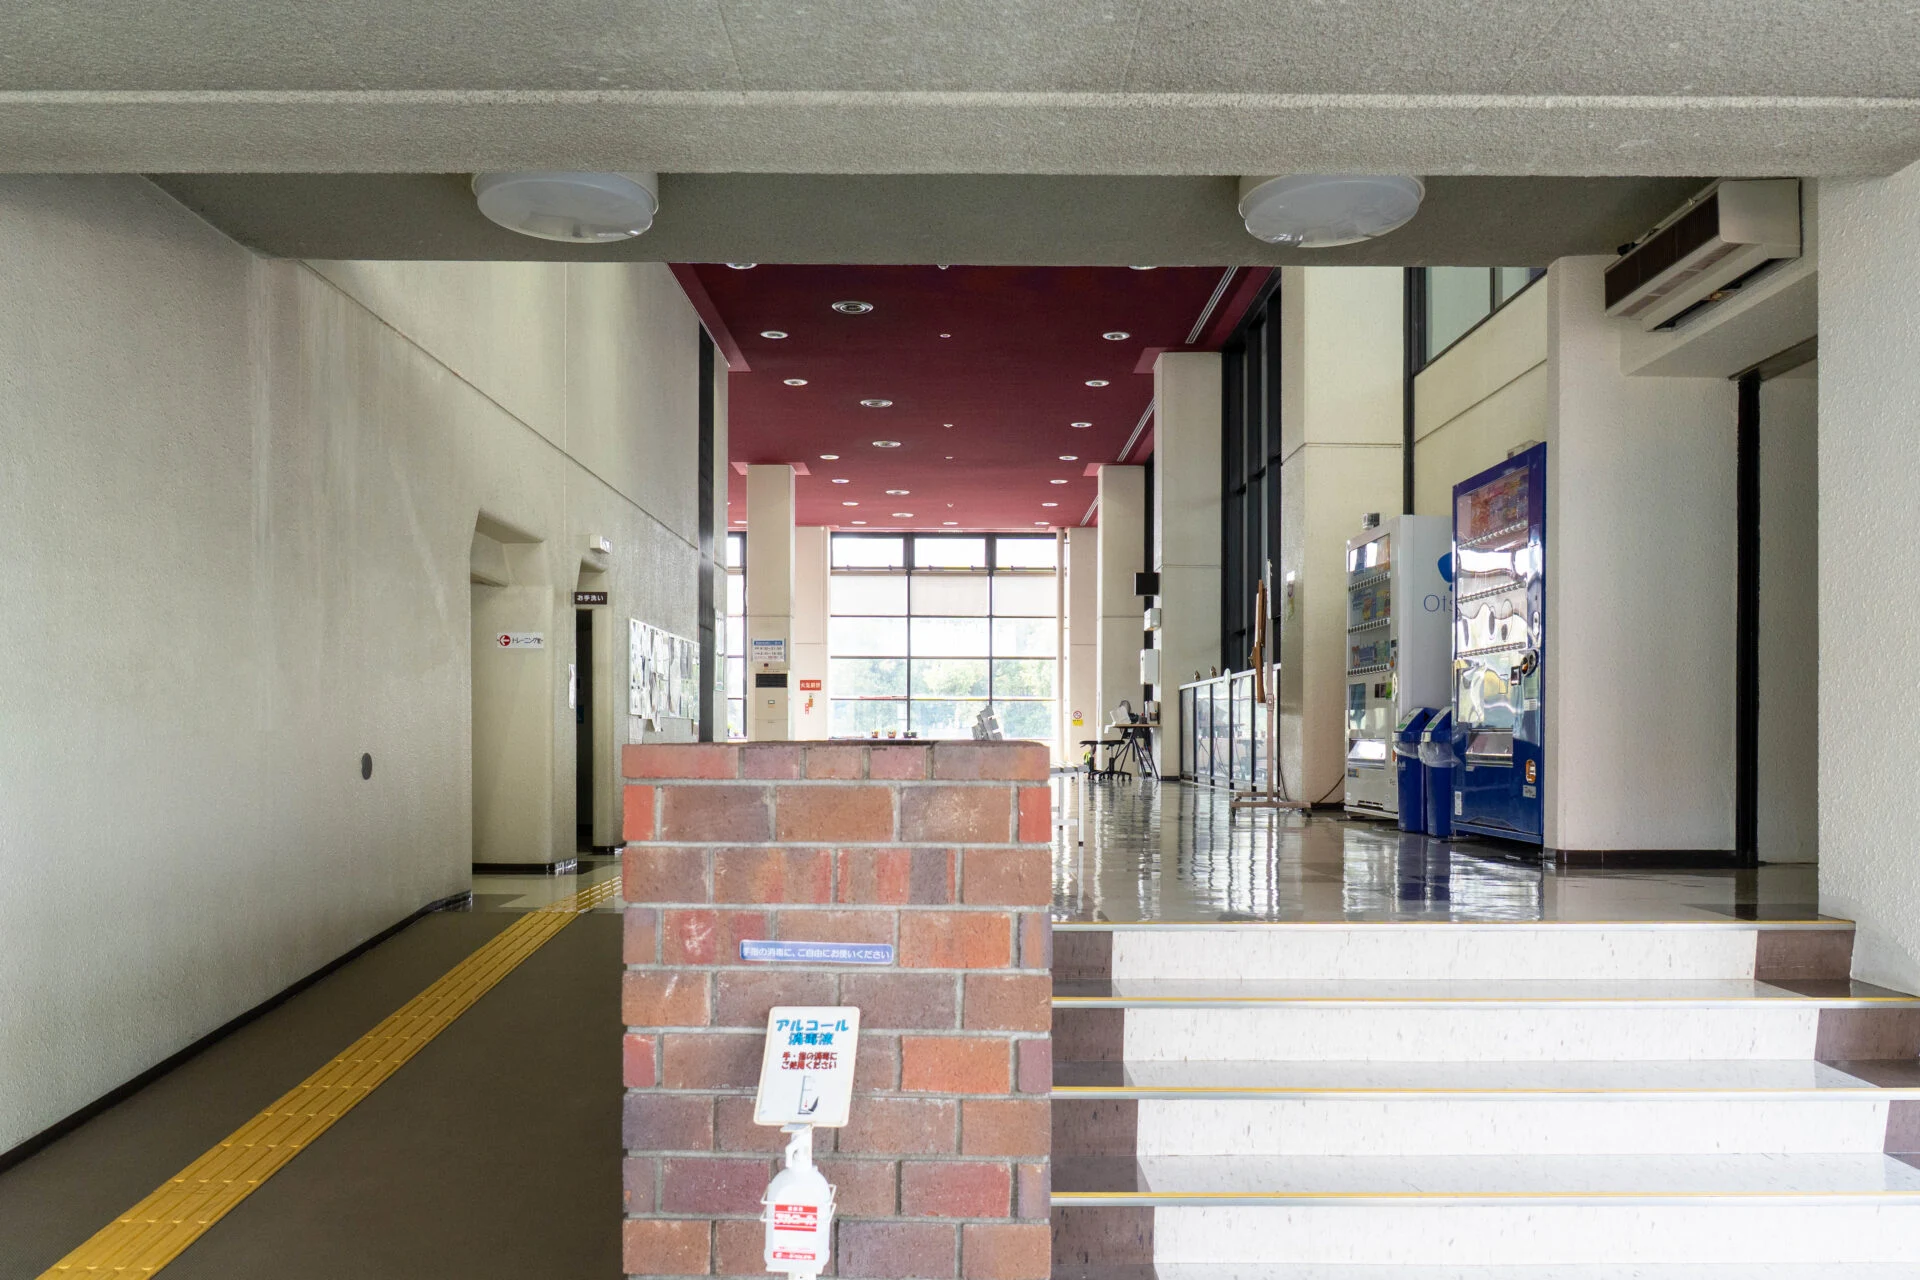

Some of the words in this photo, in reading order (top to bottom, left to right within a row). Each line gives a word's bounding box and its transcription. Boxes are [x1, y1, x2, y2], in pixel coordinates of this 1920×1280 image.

[776, 1019, 849, 1032] アルコール
[787, 1032, 835, 1046] 消毒液
